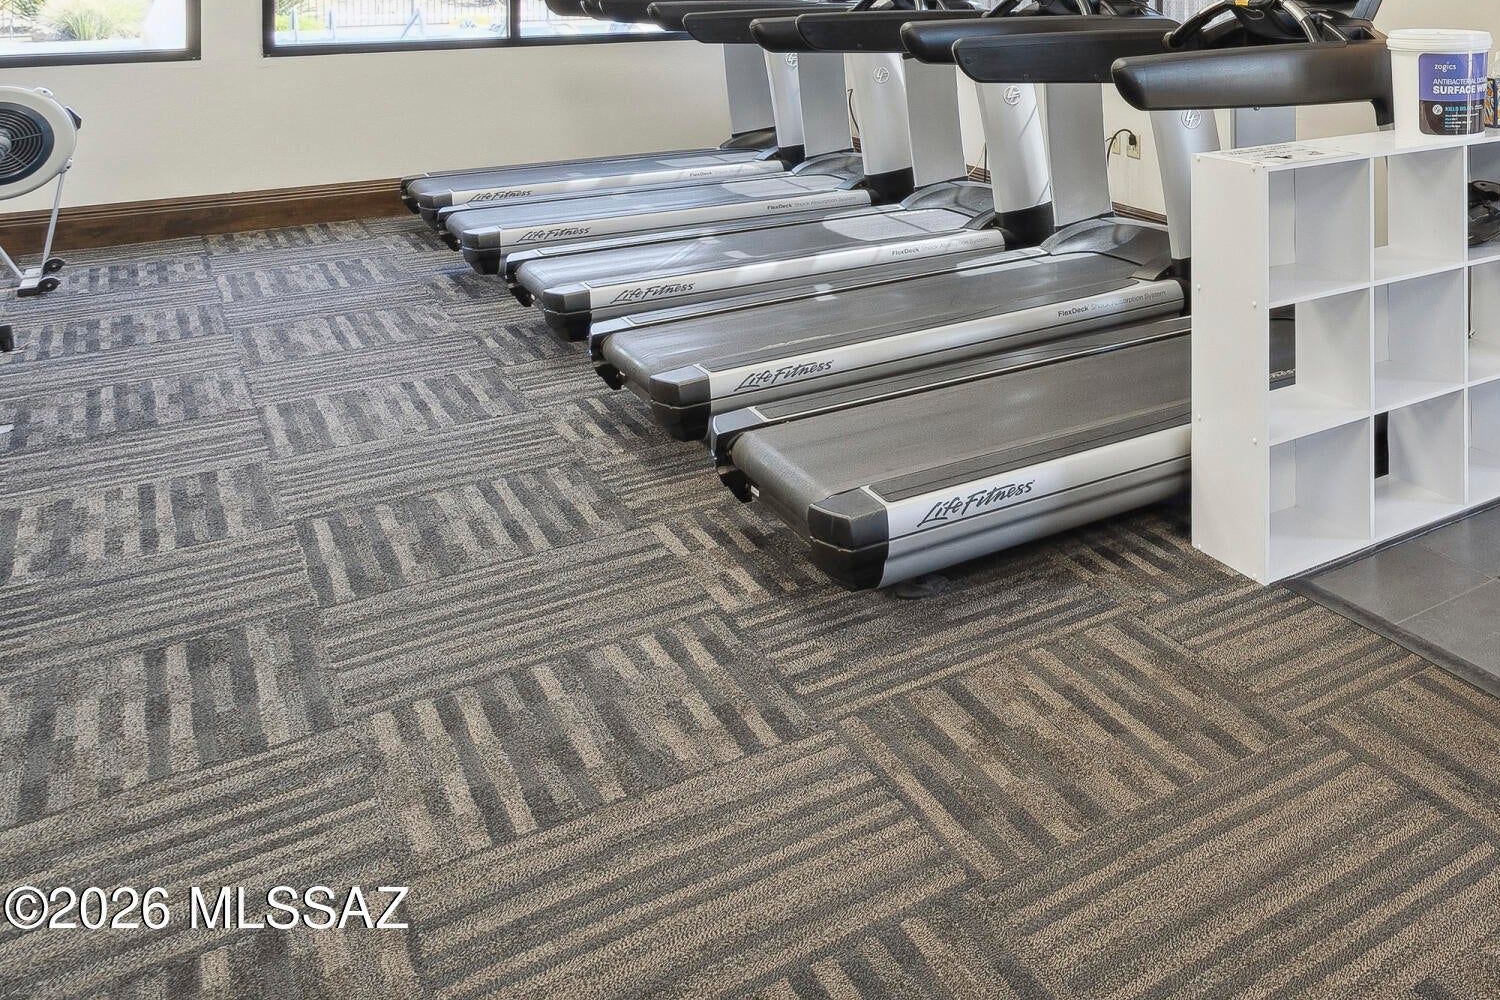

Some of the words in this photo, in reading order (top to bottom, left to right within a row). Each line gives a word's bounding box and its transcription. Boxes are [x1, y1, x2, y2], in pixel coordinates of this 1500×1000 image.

[1434, 61, 1457, 72] zogics
[1433, 85, 1475, 94] SURFACE
[1058, 304, 1089, 317] FlexDeck
